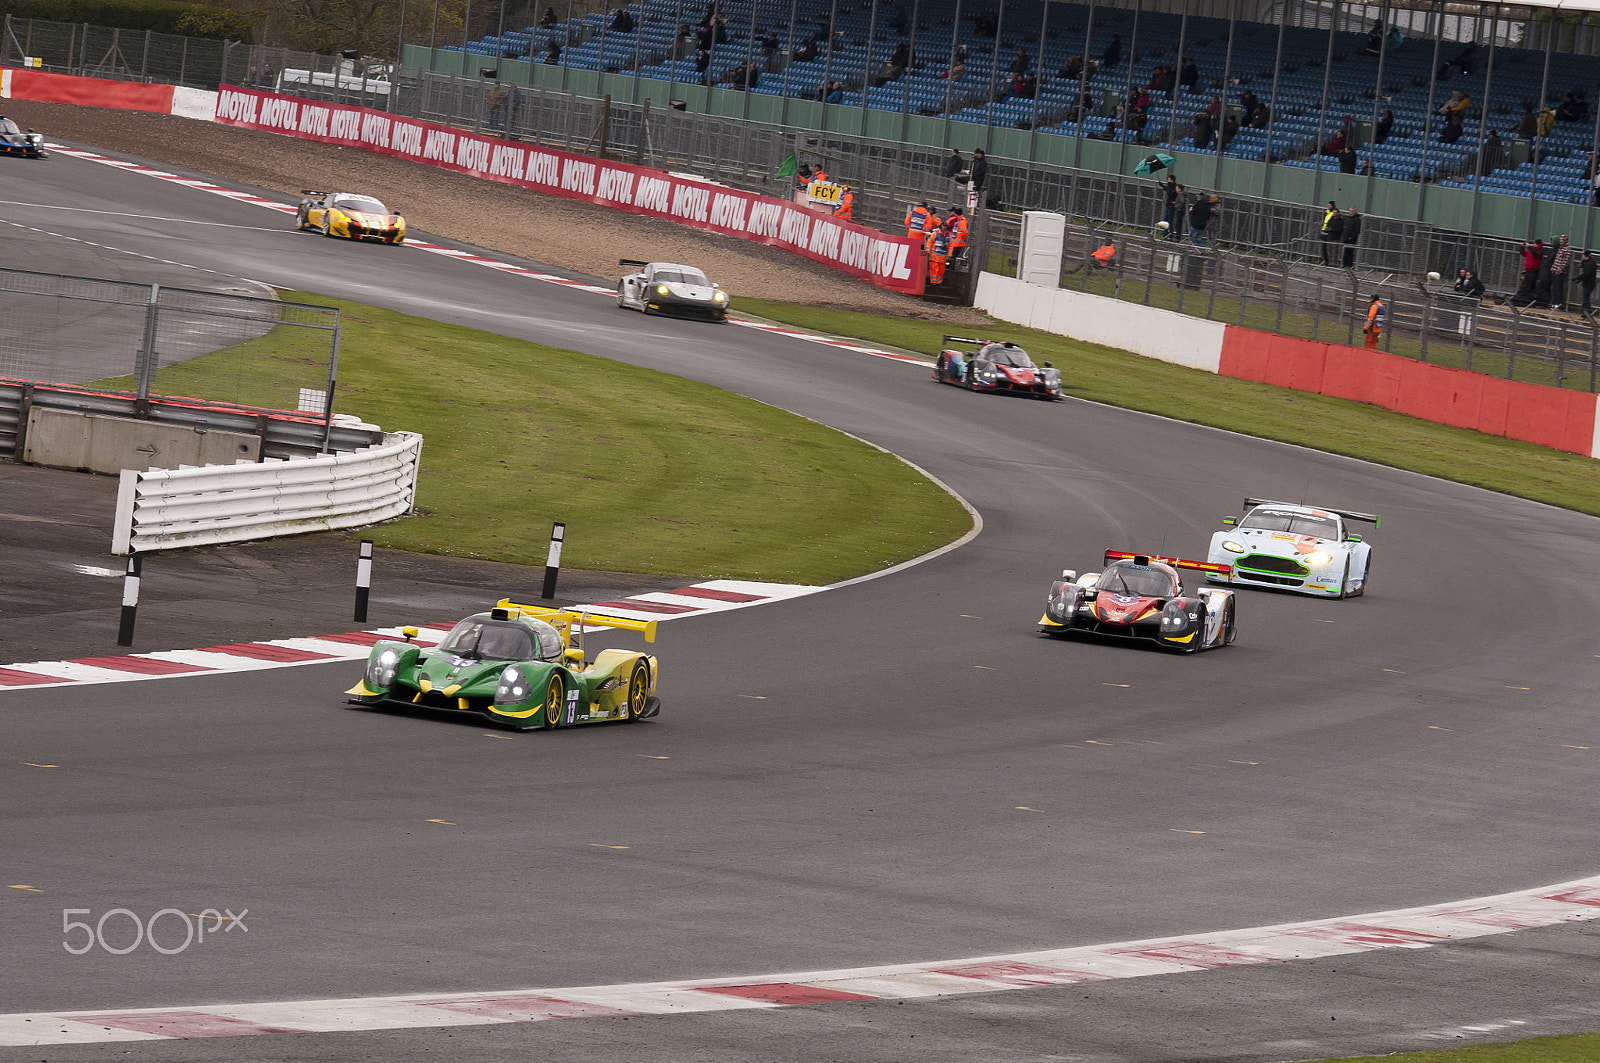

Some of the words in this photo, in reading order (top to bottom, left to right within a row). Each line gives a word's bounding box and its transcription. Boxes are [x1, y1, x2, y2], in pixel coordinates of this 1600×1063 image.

[217, 90, 258, 123] MOTUL
[259, 97, 298, 130] MOTUL
[299, 104, 330, 136] MOTUL
[329, 109, 361, 140] MOTUL
[361, 113, 391, 148] MOTUL
[391, 121, 423, 156] MOTUL
[423, 129, 455, 163] MOTUL
[456, 136, 490, 172] MOTUL
[489, 144, 525, 179] MOTUL
[525, 151, 559, 187] MOTUL
[561, 158, 596, 195] MOTUL
[596, 167, 634, 204] MOTUL
[634, 175, 671, 213] MOTUL
[671, 184, 710, 222] MOTUL
[709, 192, 748, 231] MOTUL
[747, 200, 782, 238] MOTUL
[779, 207, 811, 249] MOTUL
[809, 218, 842, 260] MOTUL
[839, 229, 869, 270] MOTUL
[866, 237, 911, 280] MOTUL
[815, 186, 836, 199] FCY
